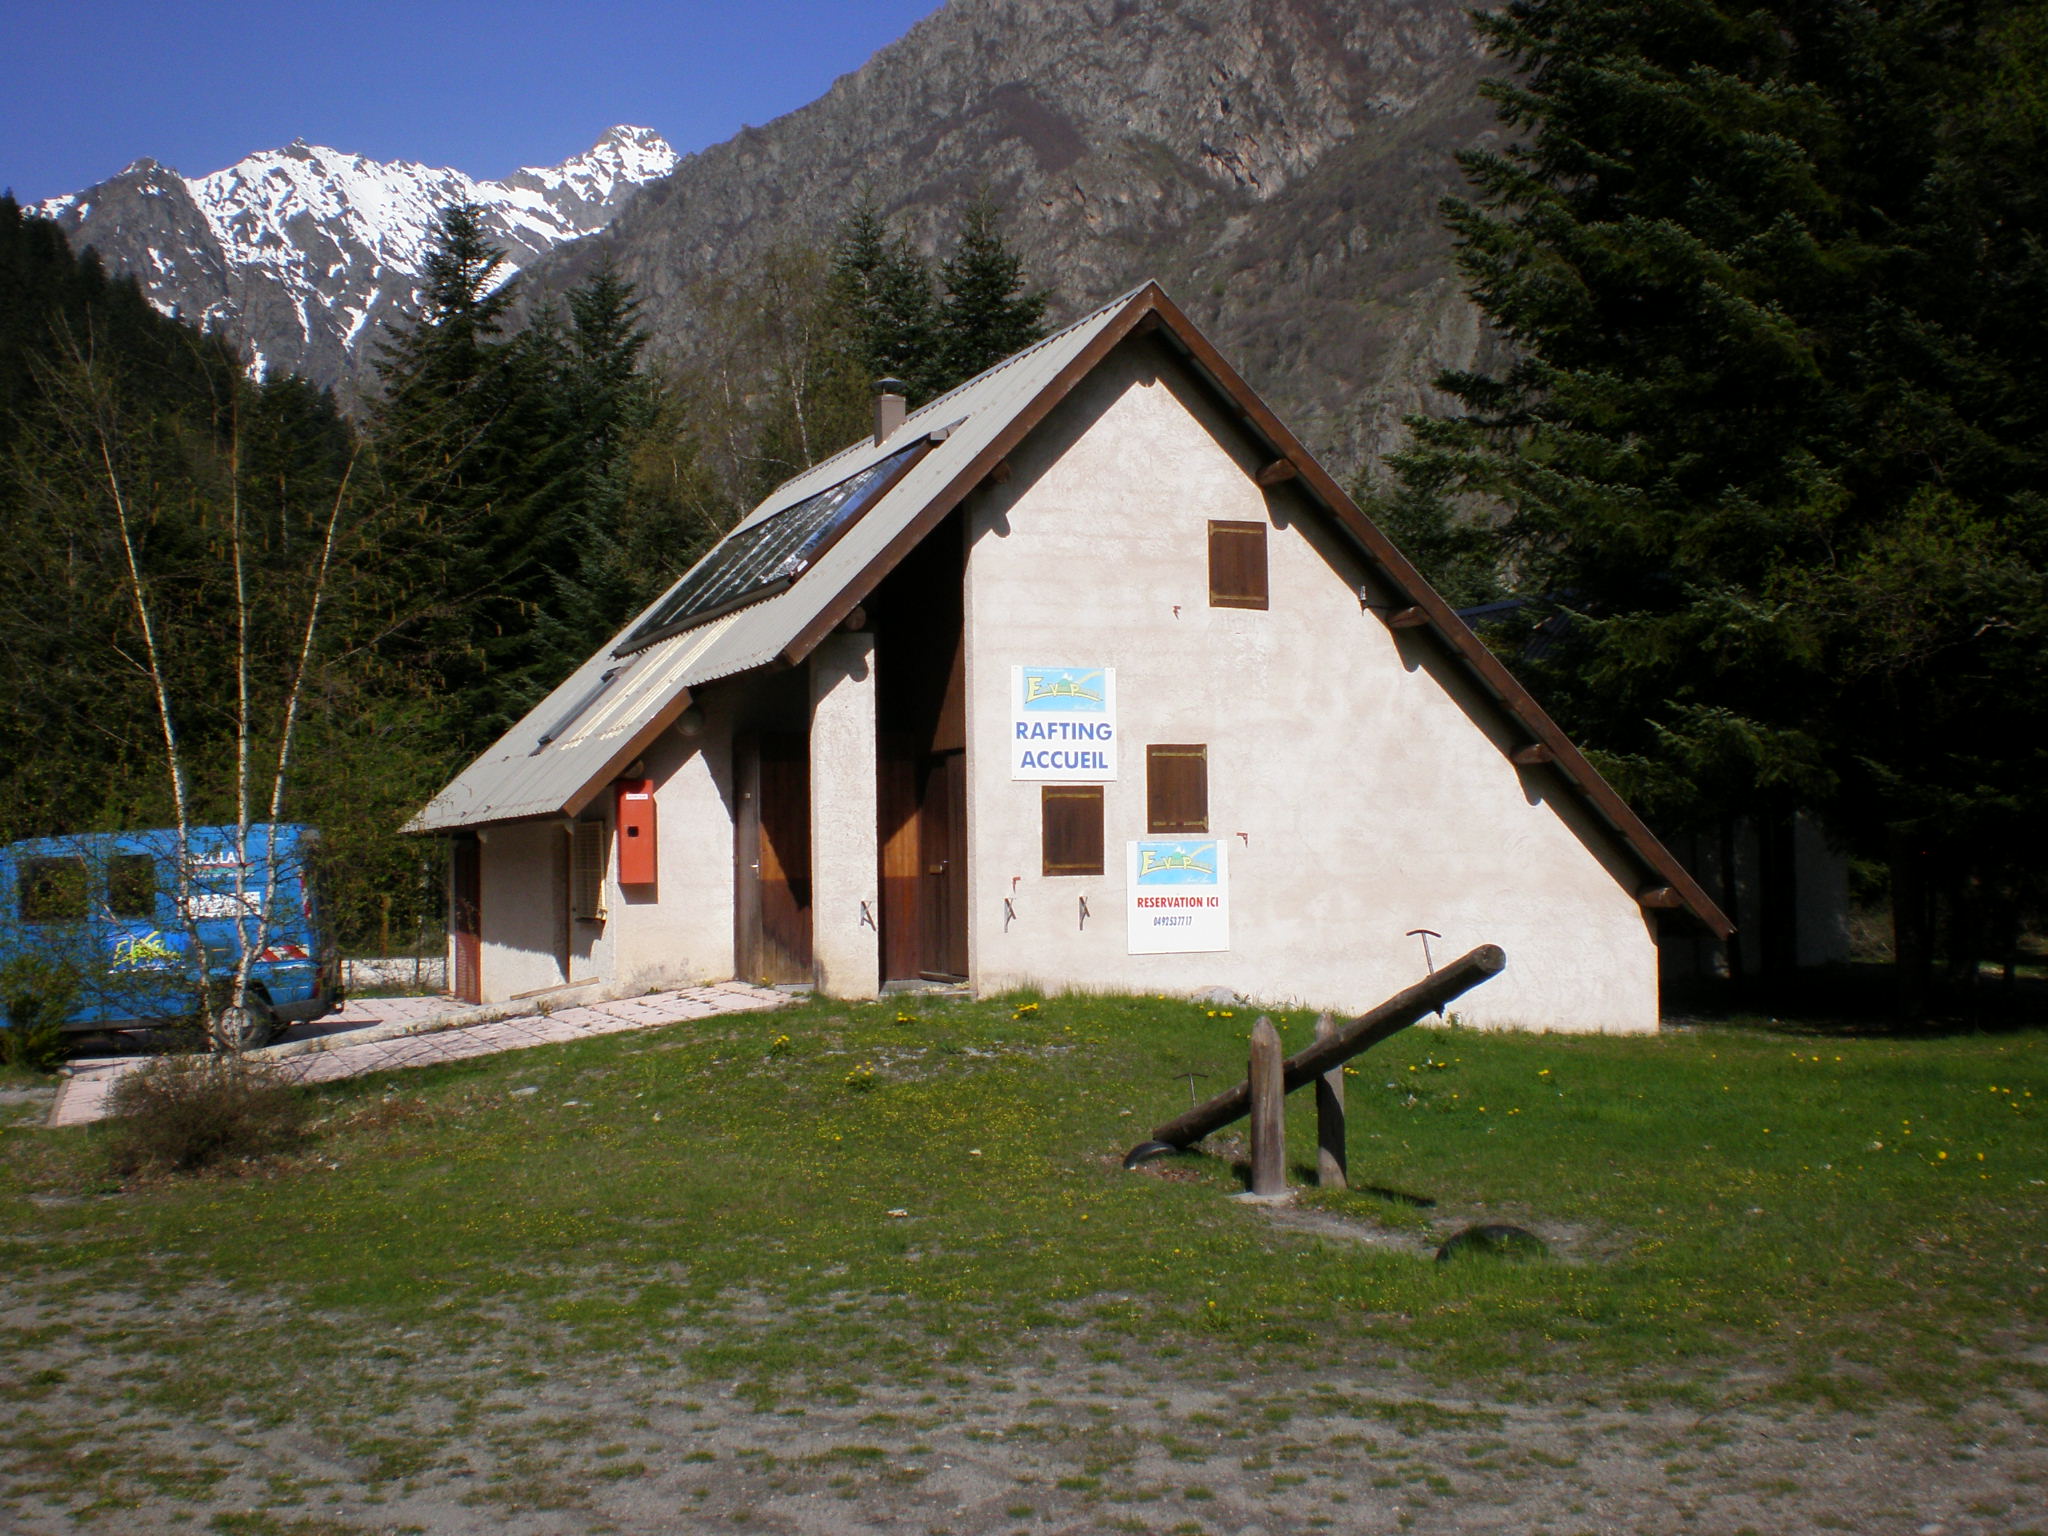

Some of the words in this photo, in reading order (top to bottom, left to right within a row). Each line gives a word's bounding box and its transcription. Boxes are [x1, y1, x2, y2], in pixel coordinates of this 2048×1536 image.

[1016, 721, 1112, 741] RAFTING
[1020, 750, 1109, 769] ACCUEIL
[1137, 896, 1203, 908] RESERVATION
[1206, 896, 1219, 908] ICI
